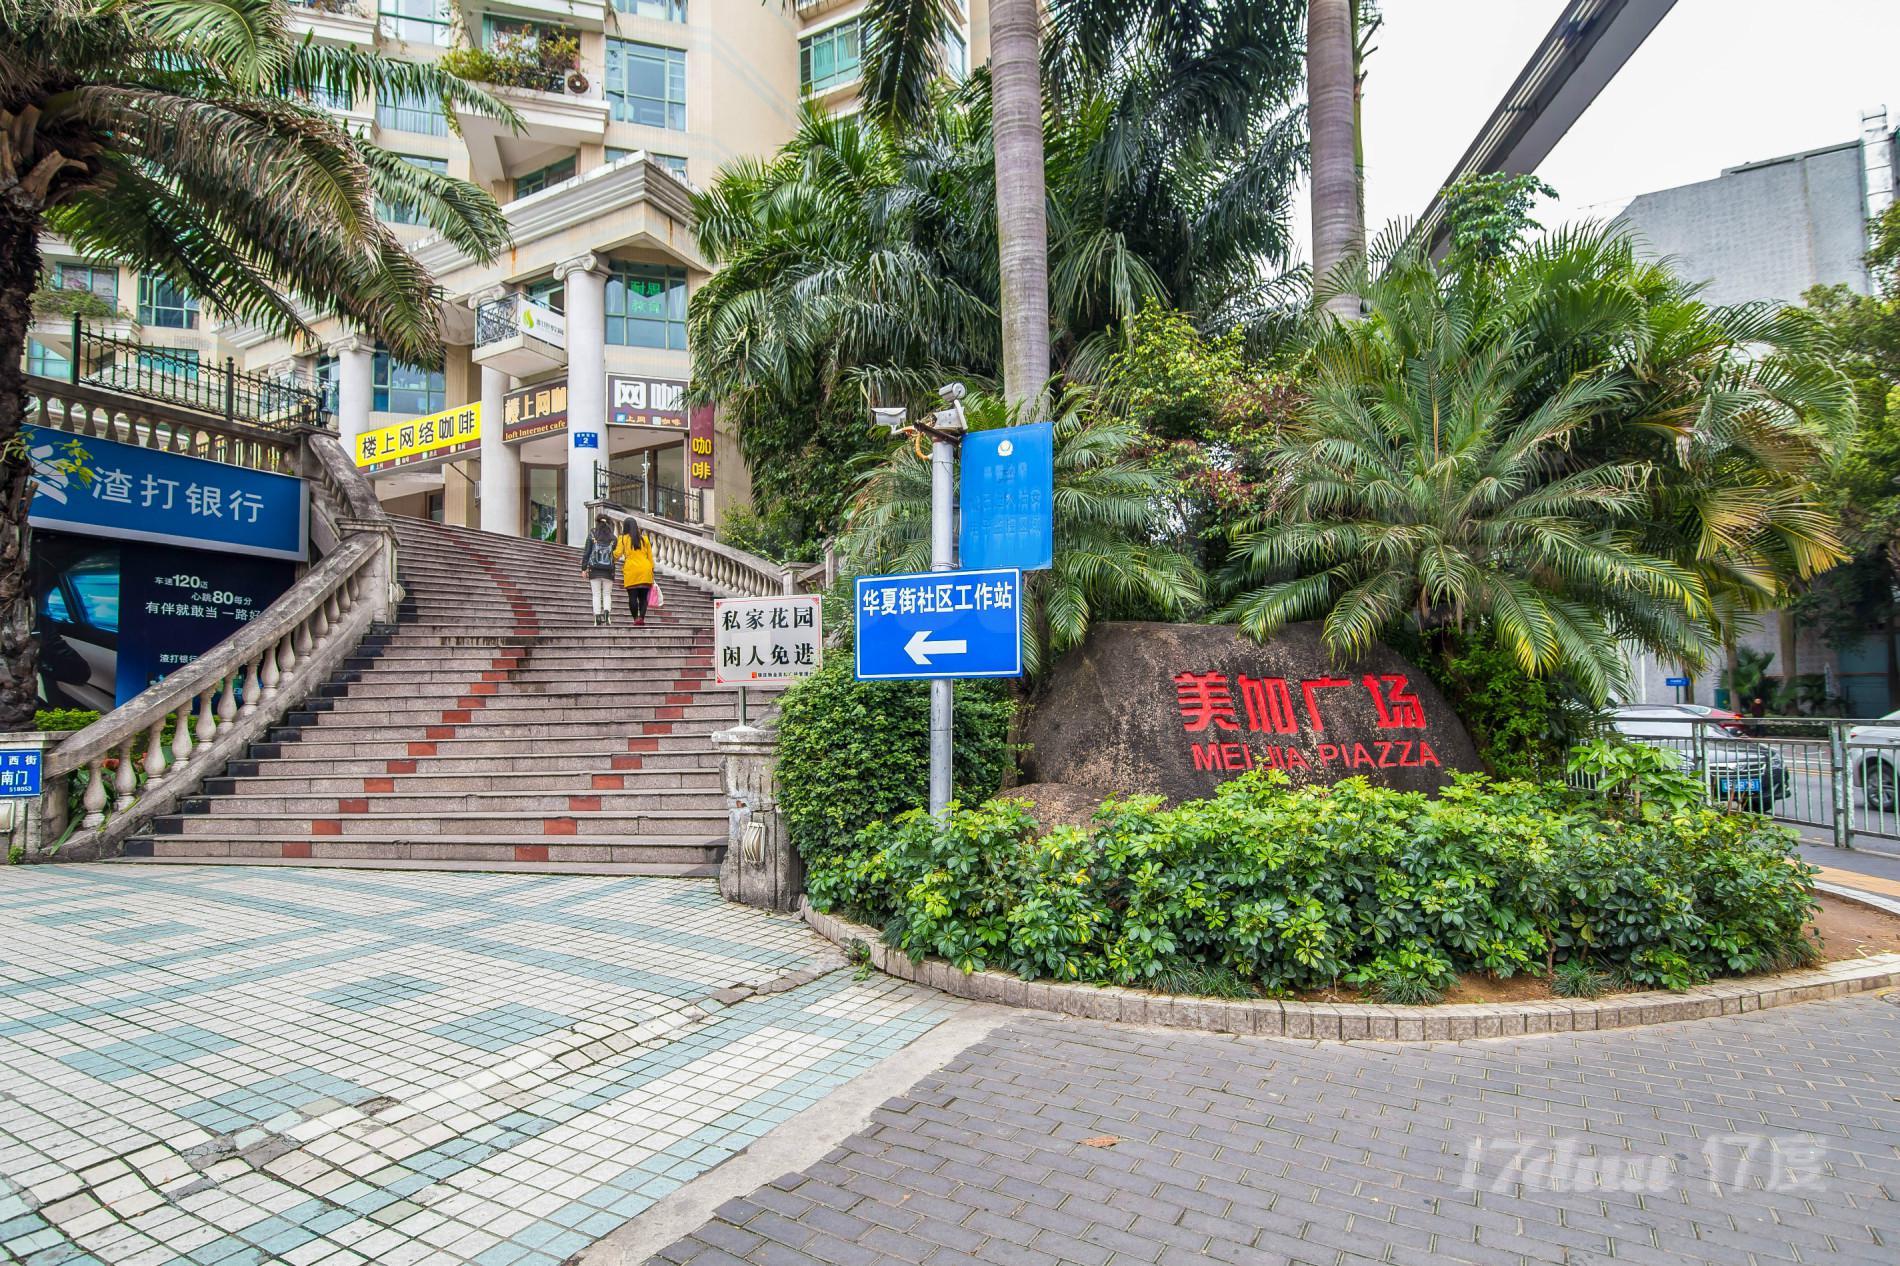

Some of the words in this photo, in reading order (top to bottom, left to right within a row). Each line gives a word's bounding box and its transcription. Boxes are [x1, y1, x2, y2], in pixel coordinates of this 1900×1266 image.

[614, 379, 683, 412] 网咖
[361, 409, 476, 459] 楼上网络咖啡
[505, 430, 518, 441] loft
[549, 419, 566, 430] cafe
[692, 437, 712, 480] 咖啡
[91, 466, 265, 524] 渣打银行
[154, 574, 209, 589] 车速120迈
[145, 601, 218, 619] 有伴就敢当
[191, 590, 253, 606] 心跳80每分
[862, 581, 1013, 617] 华夏街社区工作站
[722, 606, 814, 631] 私家花园
[722, 642, 814, 668] 闲人免进
[1174, 670, 1427, 734] 美加广场
[1317, 740, 1441, 768] PIAZZA
[1, 769, 28, 786] 南门
